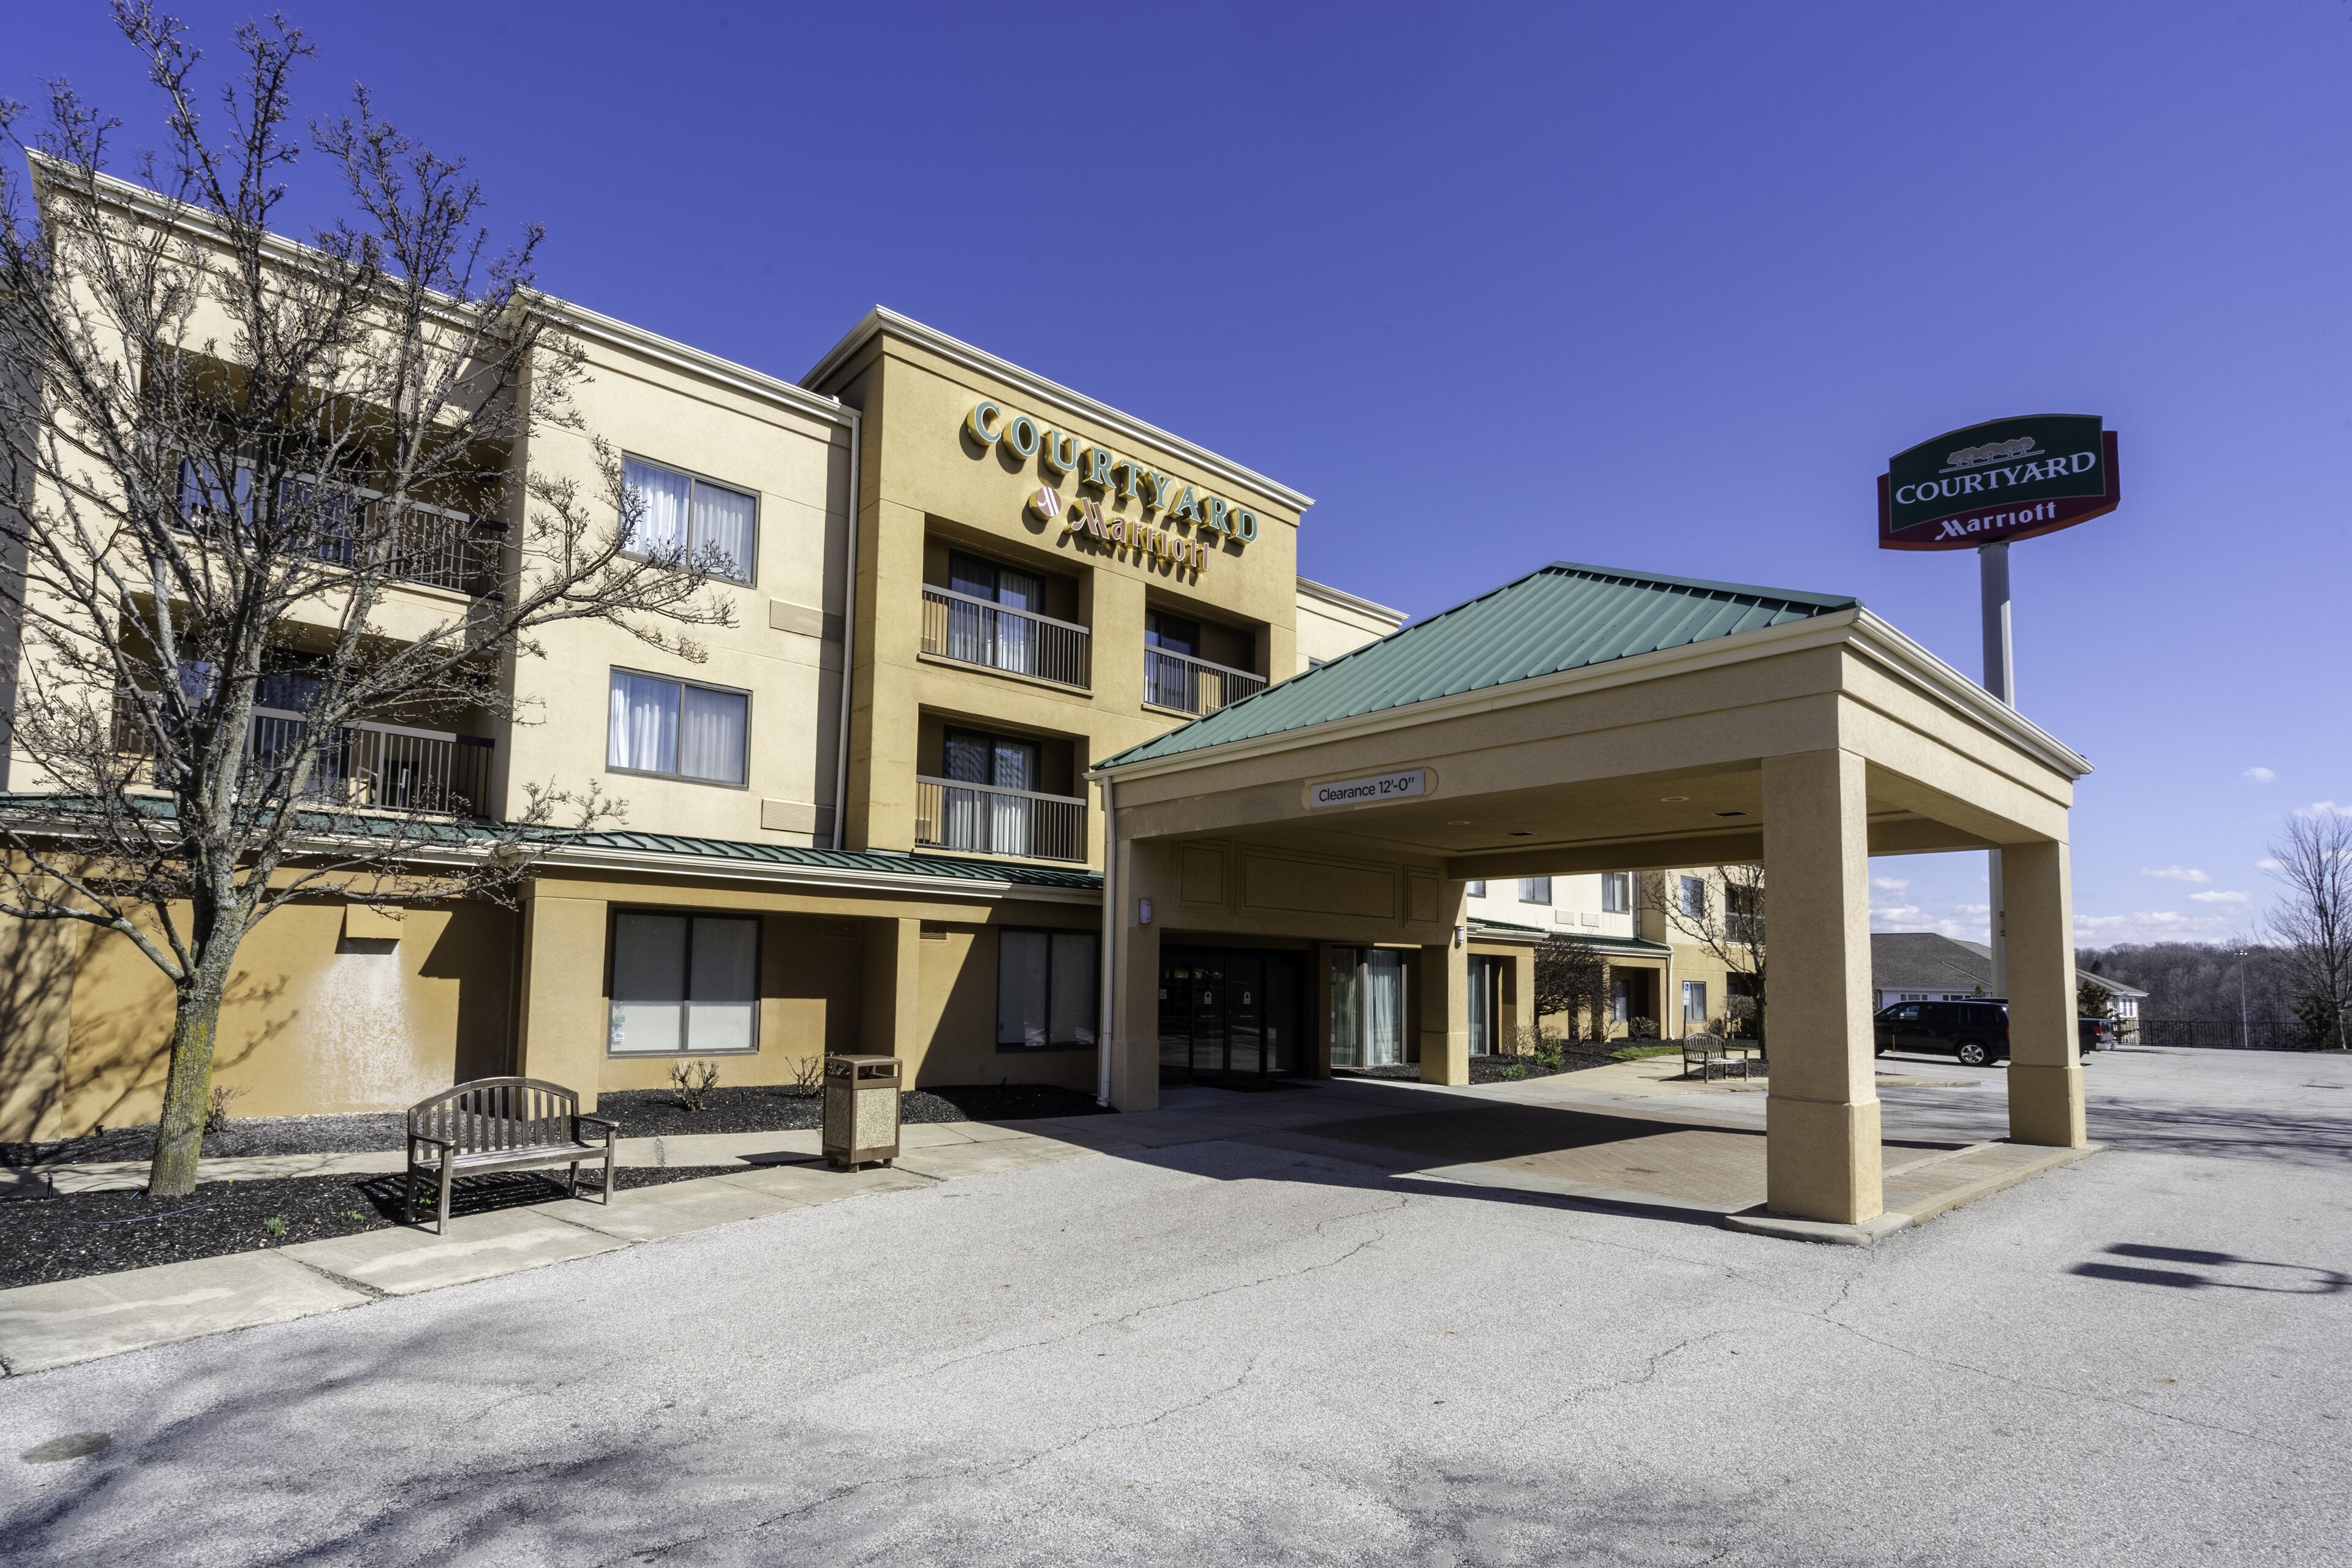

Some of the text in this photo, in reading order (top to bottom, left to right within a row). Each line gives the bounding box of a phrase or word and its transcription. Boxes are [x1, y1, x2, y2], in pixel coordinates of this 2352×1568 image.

[971, 401, 1257, 543] COURTYARD
[1896, 451, 2096, 504] COURTYARD
[1071, 497, 1210, 571] Marriott
[1935, 501, 2056, 540] Marriott
[1319, 785, 1376, 802] Clearance
